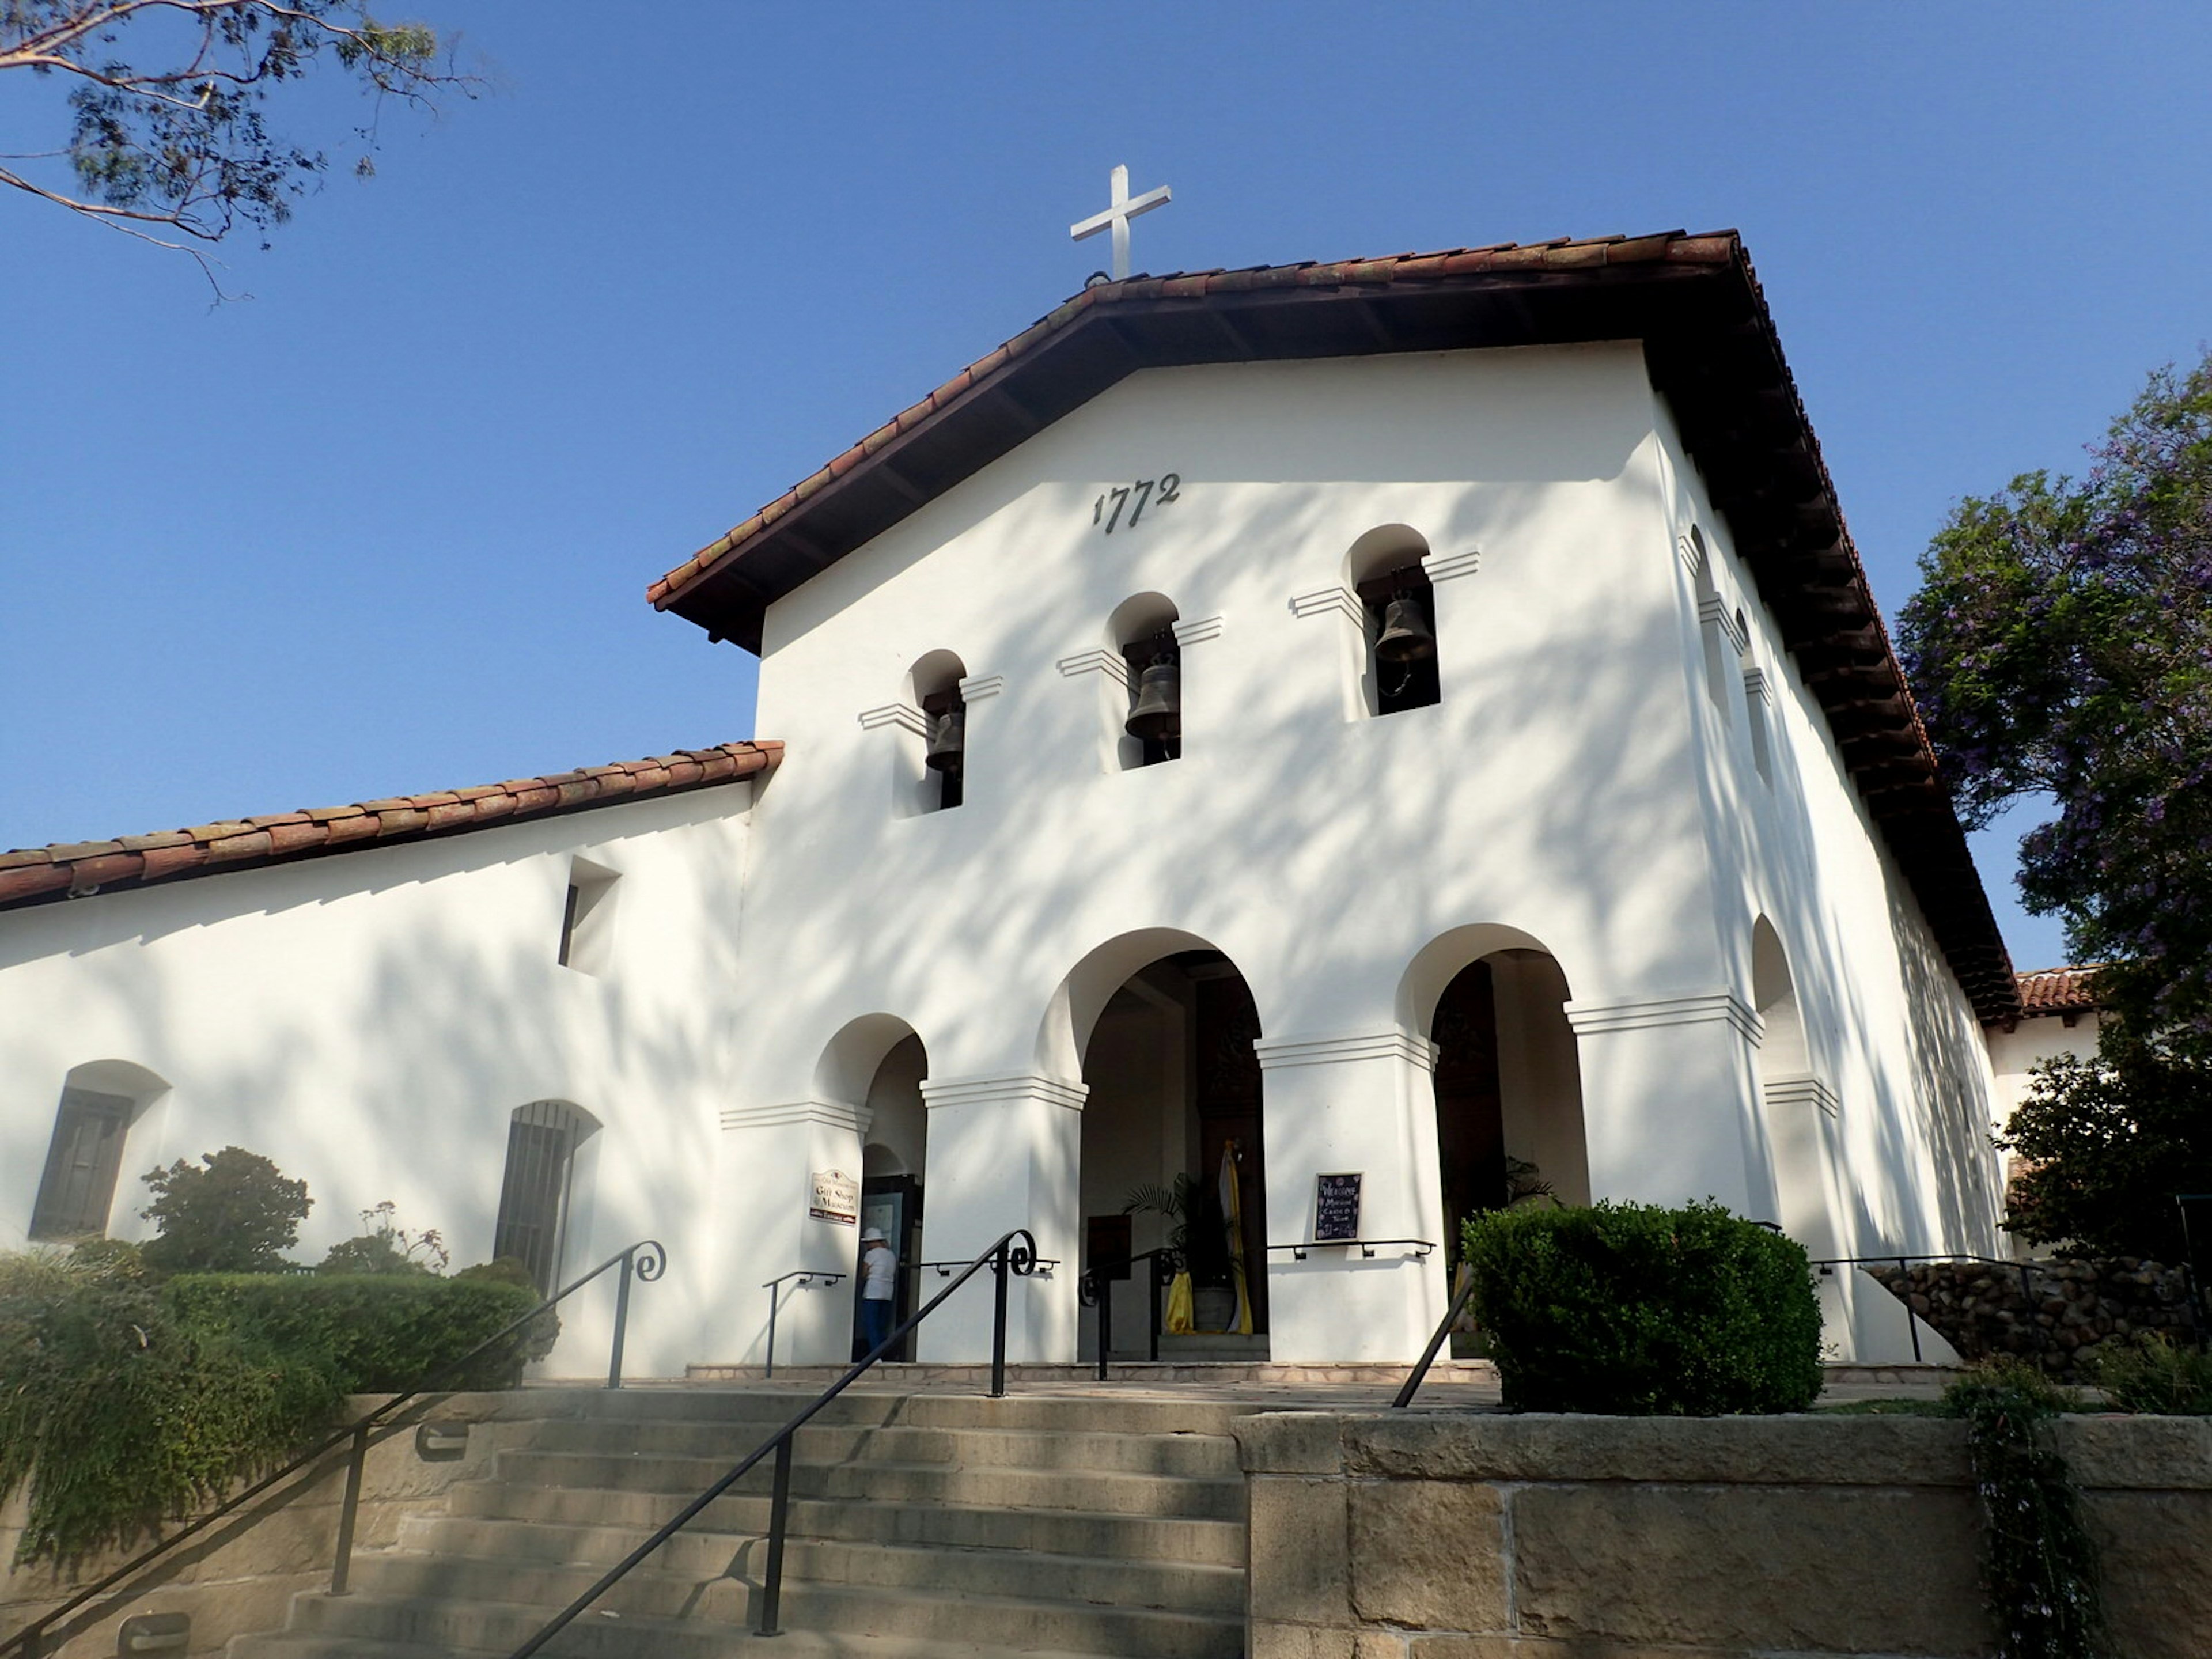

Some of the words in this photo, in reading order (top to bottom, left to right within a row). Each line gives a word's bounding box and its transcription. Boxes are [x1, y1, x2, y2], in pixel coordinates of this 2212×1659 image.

[1093, 473, 1180, 535] 1772
[816, 1185, 832, 1196] Gift
[835, 1189, 854, 1203] Shop
[821, 1197, 855, 1211] Museum
